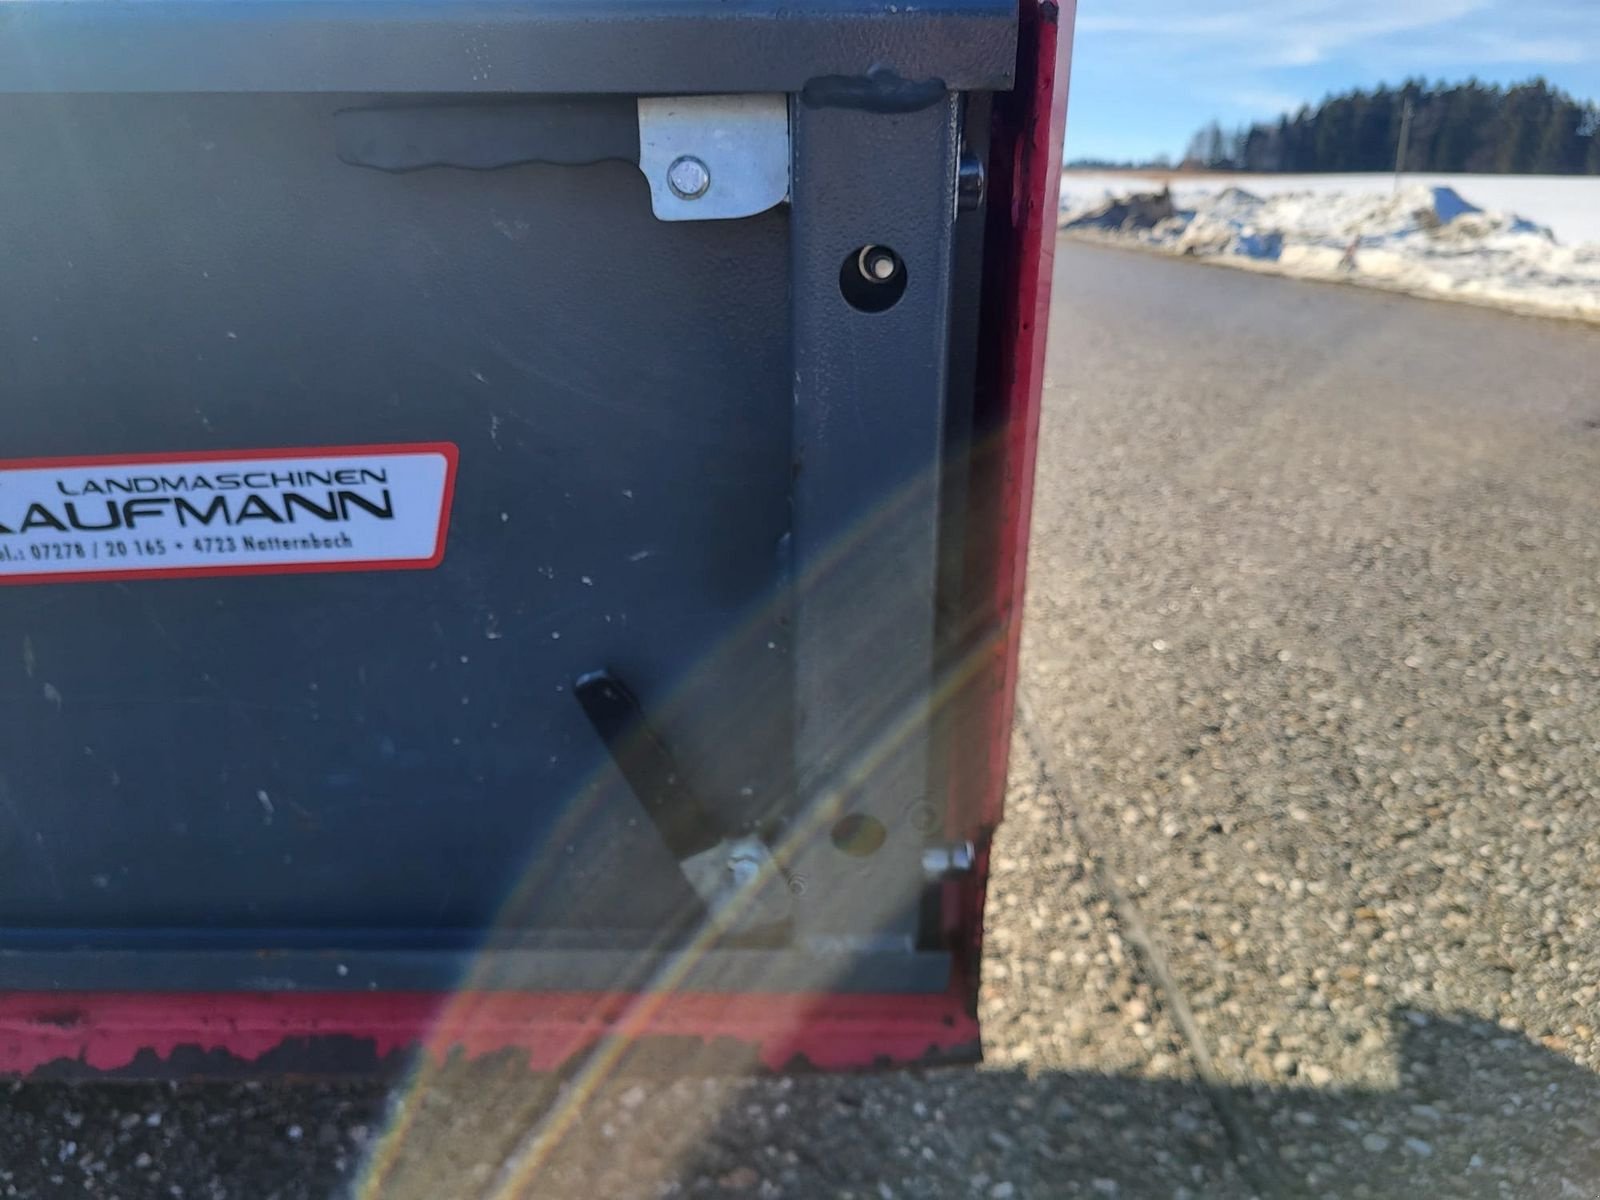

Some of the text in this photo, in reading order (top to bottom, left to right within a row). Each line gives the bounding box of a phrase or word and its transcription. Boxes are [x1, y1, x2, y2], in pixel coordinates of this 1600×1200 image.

[56, 467, 389, 497] LANDMASCHINEN
[0, 489, 394, 535] AUFMANN
[30, 543, 86, 560] 07278
[105, 541, 128, 558] 20
[135, 538, 167, 556] 165
[193, 535, 237, 553] 4723
